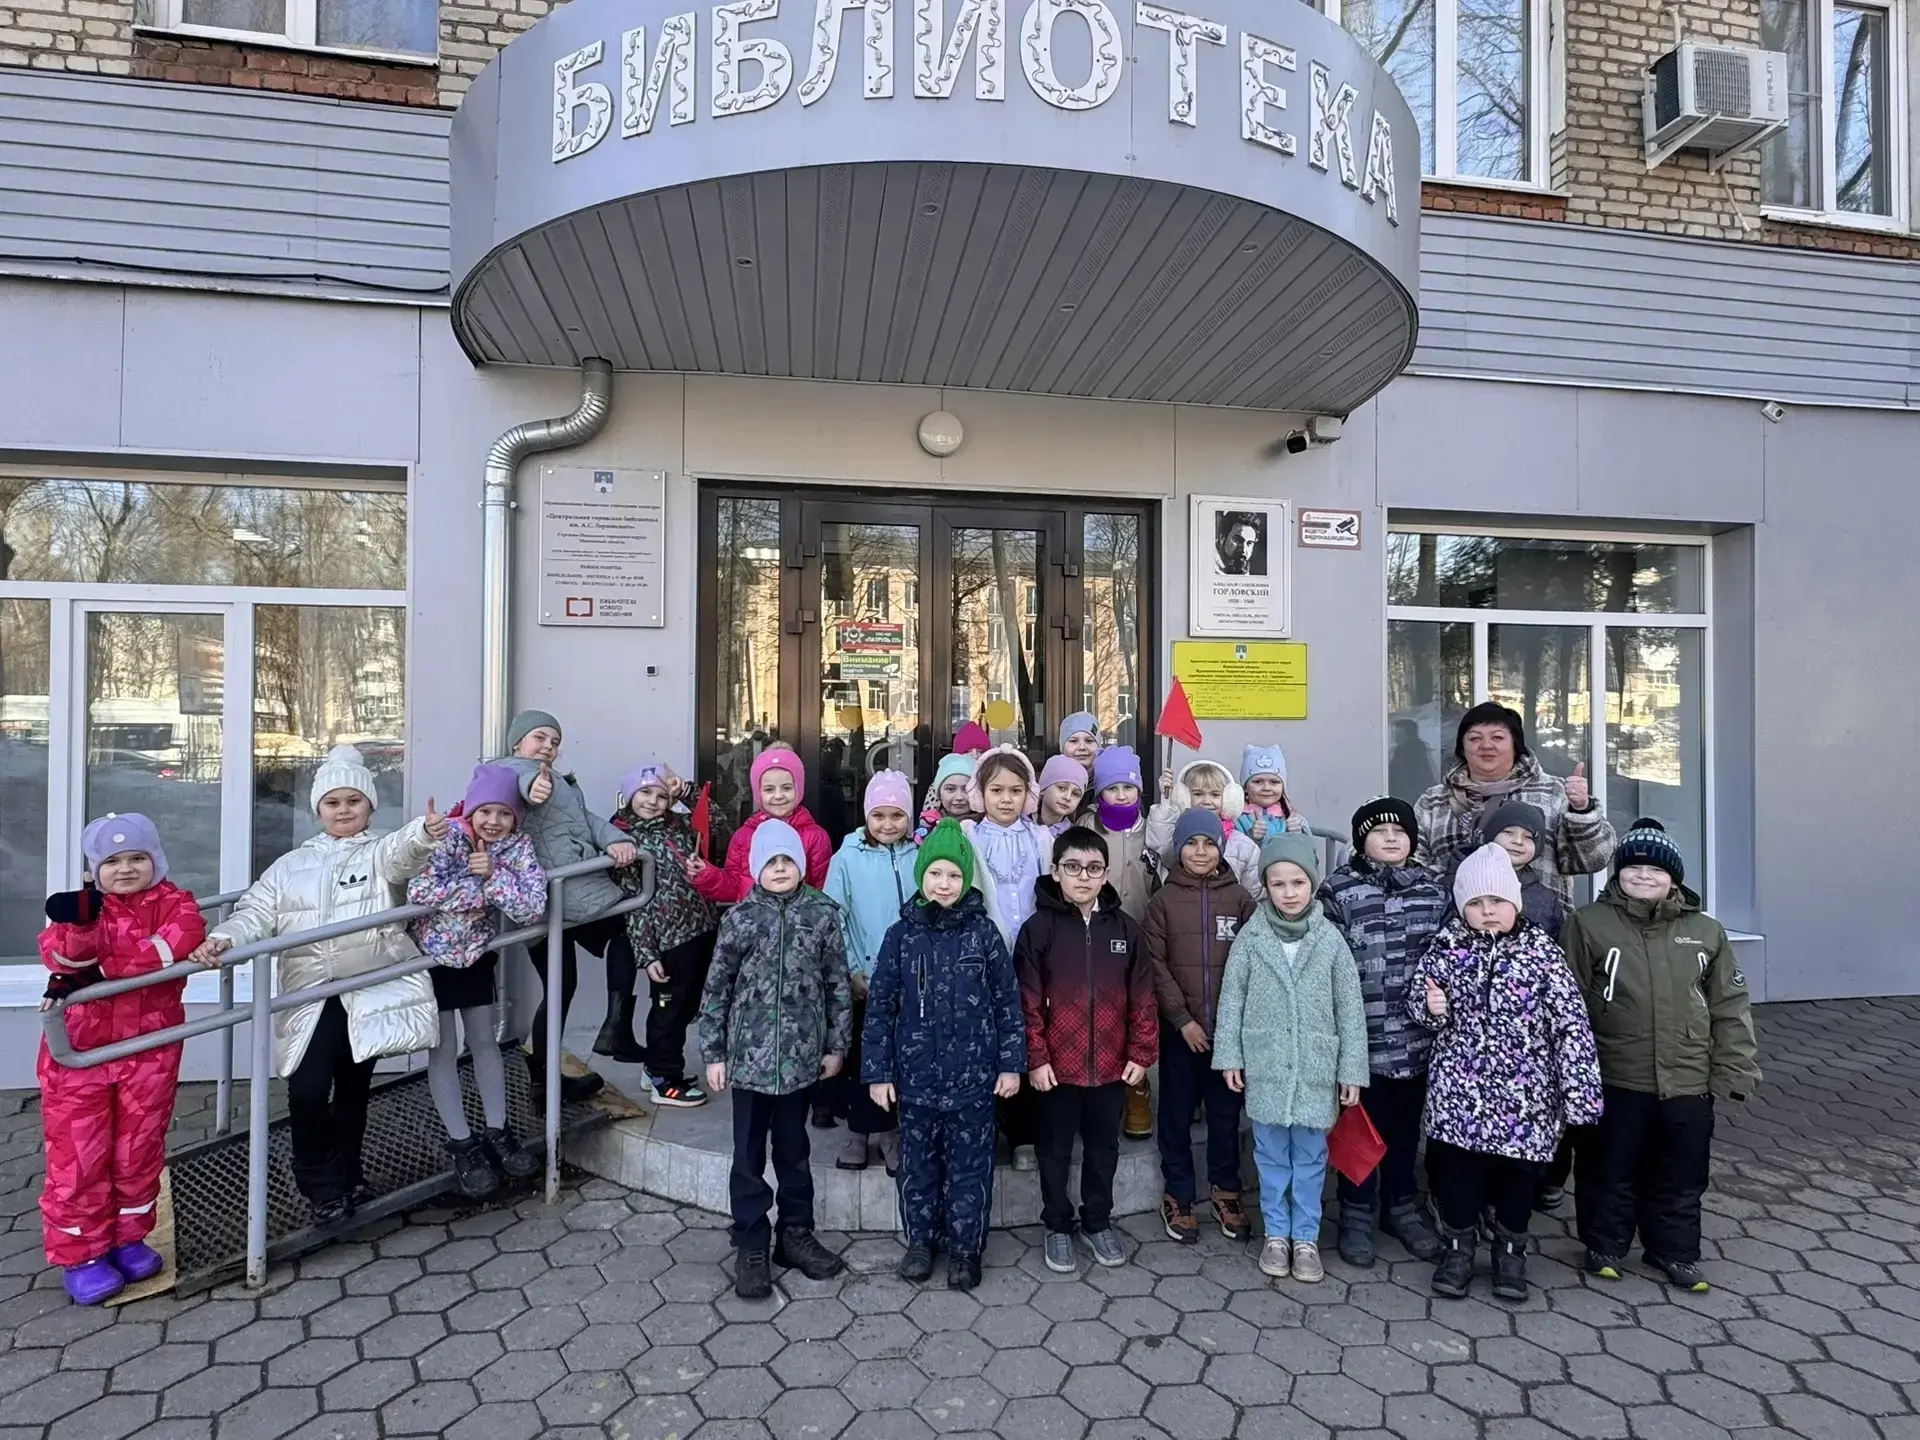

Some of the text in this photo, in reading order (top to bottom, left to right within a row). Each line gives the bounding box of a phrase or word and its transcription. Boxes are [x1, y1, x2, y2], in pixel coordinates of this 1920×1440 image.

[550, 0, 1400, 227] БИБЛИОТЕКА
[1213, 587, 1269, 596] ГОРЛОВСКИЙ
[843, 656, 892, 664] Внимание!
[1216, 916, 1238, 941] K
